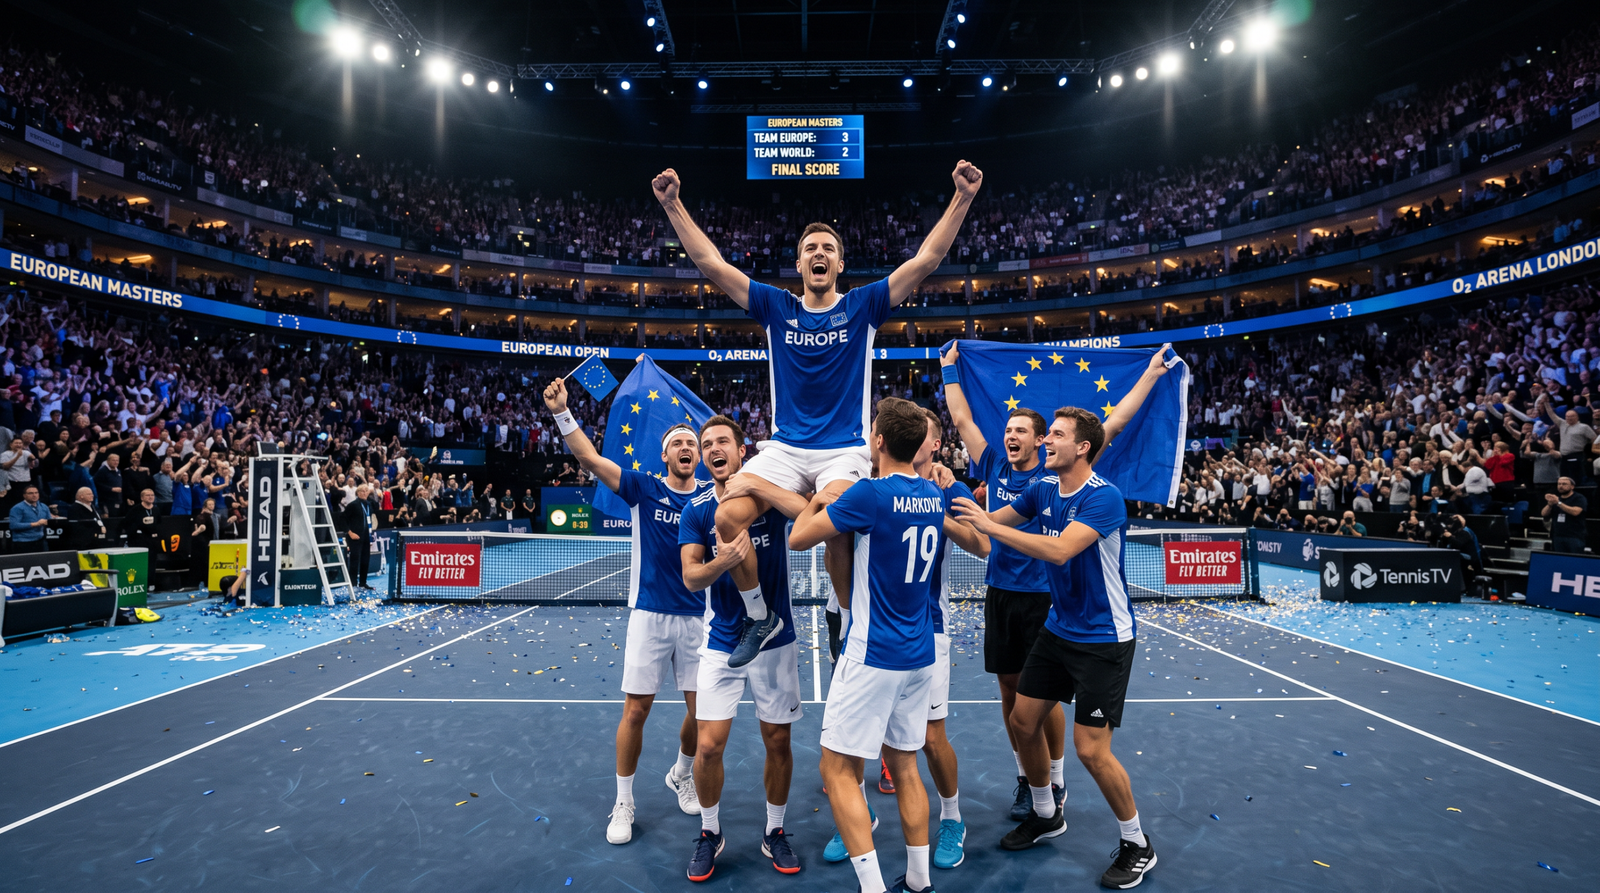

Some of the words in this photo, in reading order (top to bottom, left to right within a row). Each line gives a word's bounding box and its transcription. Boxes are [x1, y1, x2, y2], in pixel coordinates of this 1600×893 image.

[767, 118, 807, 128] EUROPEAN
[808, 118, 843, 127] MASTERS
[754, 132, 778, 143] TEAM
[780, 132, 817, 143] EUROPE:
[842, 132, 849, 142] 3
[754, 147, 778, 158] TEAM
[779, 147, 815, 158] WORLD:
[842, 147, 849, 157] 2
[771, 163, 803, 176] FINAL
[805, 163, 840, 176] SCORE
[1475, 261, 1534, 289] ARENA
[1537, 238, 1600, 273] LONDO
[10, 252, 103, 292] EUROPEAN
[107, 278, 183, 308] MASTERS
[785, 329, 848, 346] EUROPE
[1043, 336, 1121, 349] AMPIONS
[502, 341, 571, 357] EUROPEAN
[574, 346, 610, 359] OPEN
[725, 350, 768, 360] ARENA
[880, 348, 887, 360] 3
[893, 496, 943, 513] MARKOVIC
[258, 476, 272, 561] HEAD
[410, 551, 475, 566] Emirates
[902, 525, 938, 584] 19
[1169, 548, 1237, 564] Emirates
[0, 563, 71, 584] EAD
[418, 567, 433, 579] FLY
[435, 567, 465, 579] BETTER
[1179, 565, 1194, 577] FLY
[1196, 565, 1228, 577] BETTER
[1379, 568, 1452, 584] TennisTV
[117, 584, 145, 596] ROLEX
[82, 643, 267, 656] ATP
